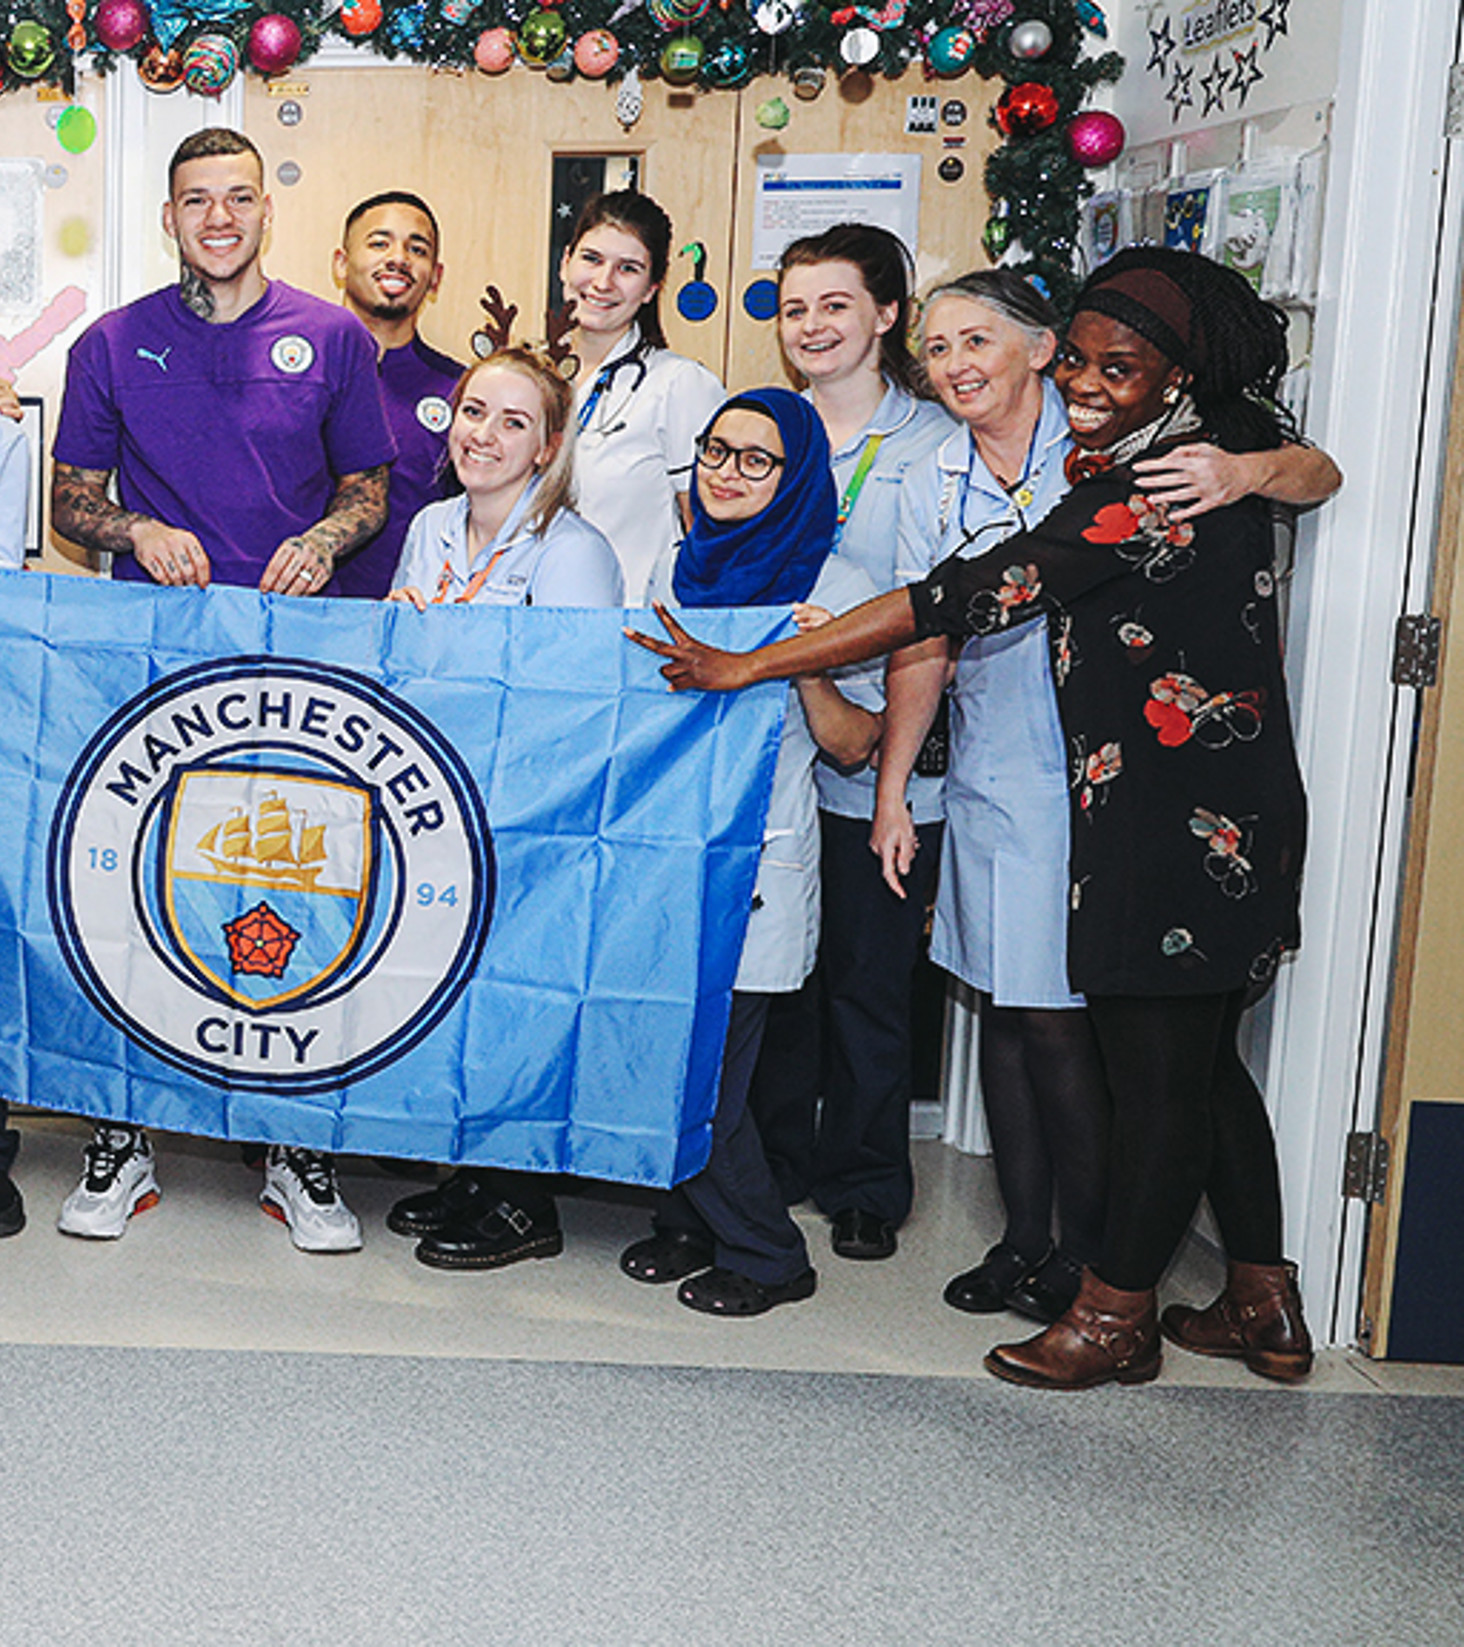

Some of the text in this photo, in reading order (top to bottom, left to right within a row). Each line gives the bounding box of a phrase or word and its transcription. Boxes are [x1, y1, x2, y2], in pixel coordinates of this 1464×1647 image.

[106, 691, 445, 836] MANCHESTER
[87, 847, 118, 871] 18
[416, 882, 458, 908] 94
[196, 1017, 318, 1063] CITY
